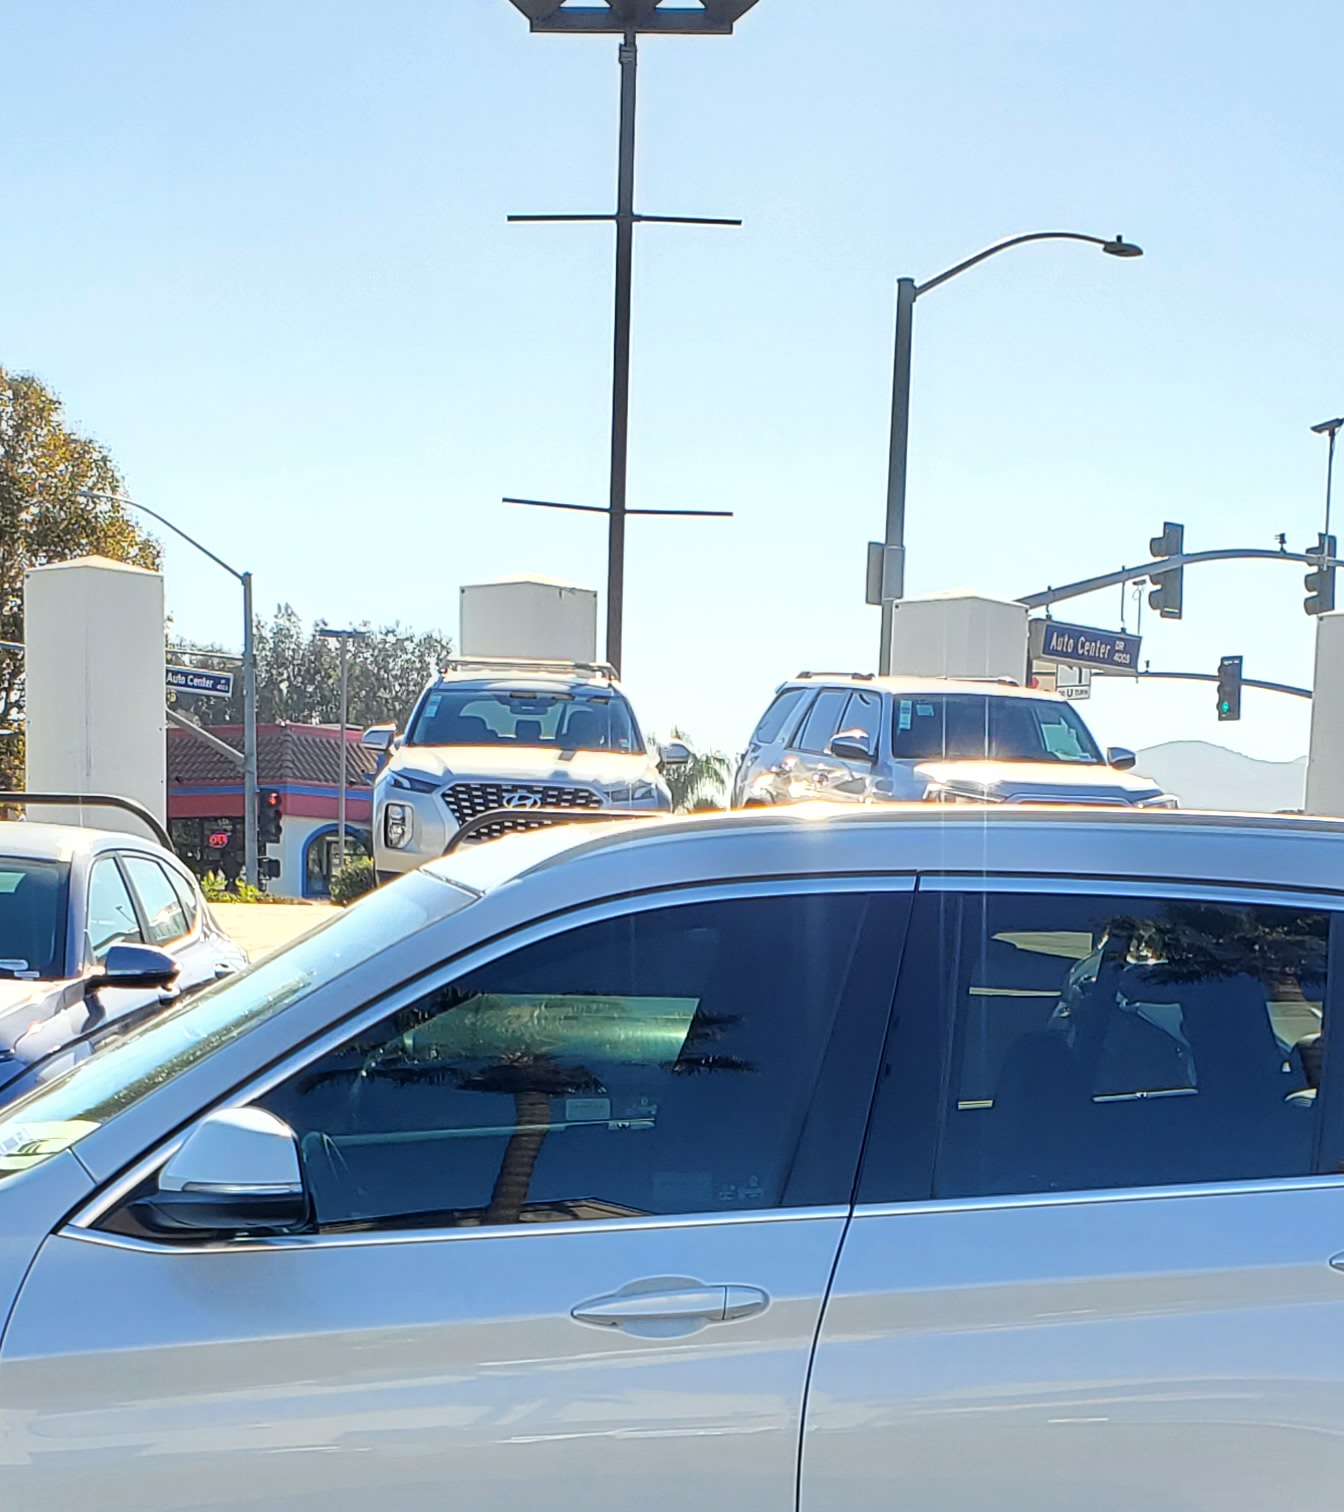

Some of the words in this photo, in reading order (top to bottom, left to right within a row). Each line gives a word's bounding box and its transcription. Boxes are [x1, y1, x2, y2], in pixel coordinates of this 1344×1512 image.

[1050, 631, 1074, 653] Auto
[1078, 636, 1111, 659] Center
[1115, 641, 1125, 651] DR
[167, 672, 186, 686] Auto
[187, 675, 214, 689] Center
[1067, 688, 1074, 698] U
